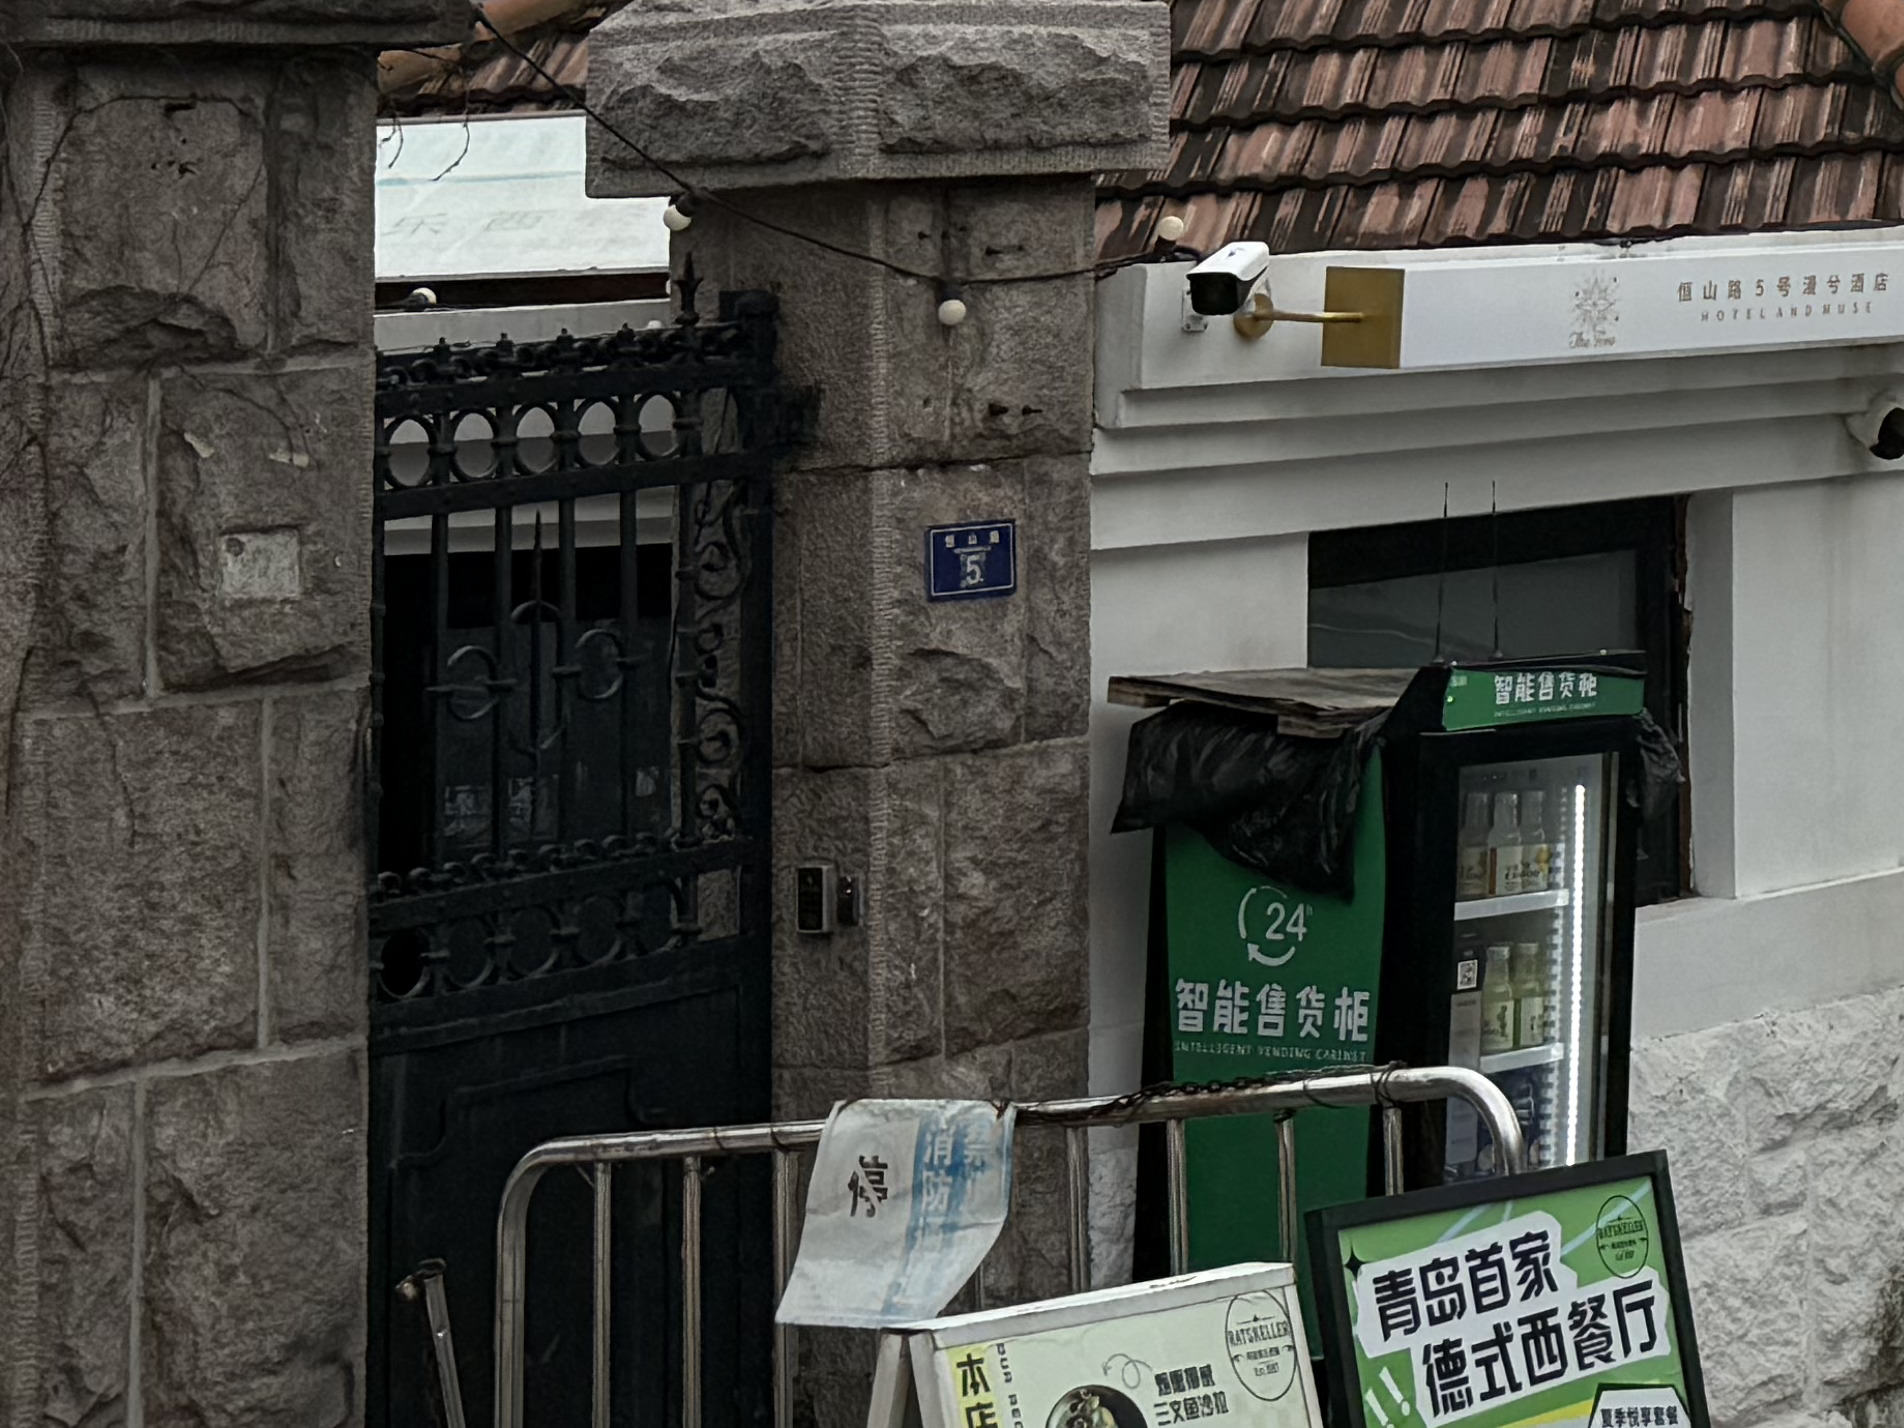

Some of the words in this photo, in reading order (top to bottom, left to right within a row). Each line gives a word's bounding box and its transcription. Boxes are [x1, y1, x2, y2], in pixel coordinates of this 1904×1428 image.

[966, 555, 981, 585] 5
[1495, 671, 1598, 705] 智能售货柜
[1175, 978, 1371, 1041] 智能售货柜
[1373, 1230, 1558, 1342] 青岛首家
[1422, 1279, 1657, 1418] 德式西餐厅
